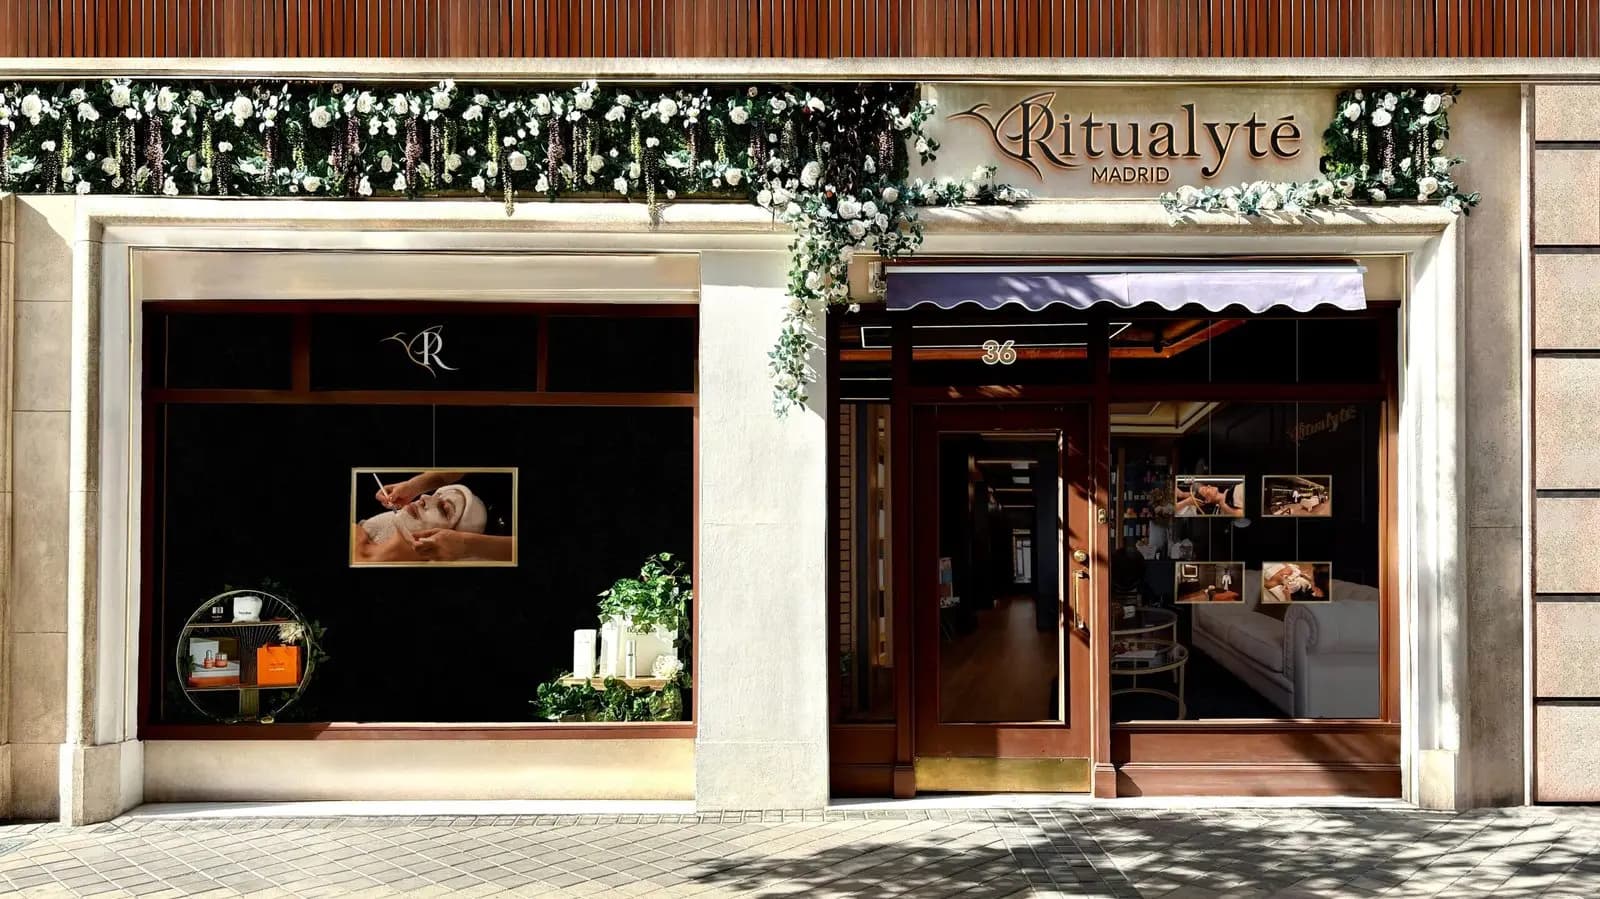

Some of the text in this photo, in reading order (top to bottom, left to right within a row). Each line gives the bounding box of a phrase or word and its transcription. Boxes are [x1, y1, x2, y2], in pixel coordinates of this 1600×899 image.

[994, 91, 1302, 181] Ritualyté
[1091, 166, 1171, 183] MADRID
[406, 324, 461, 378] R
[982, 340, 1017, 365] 36
